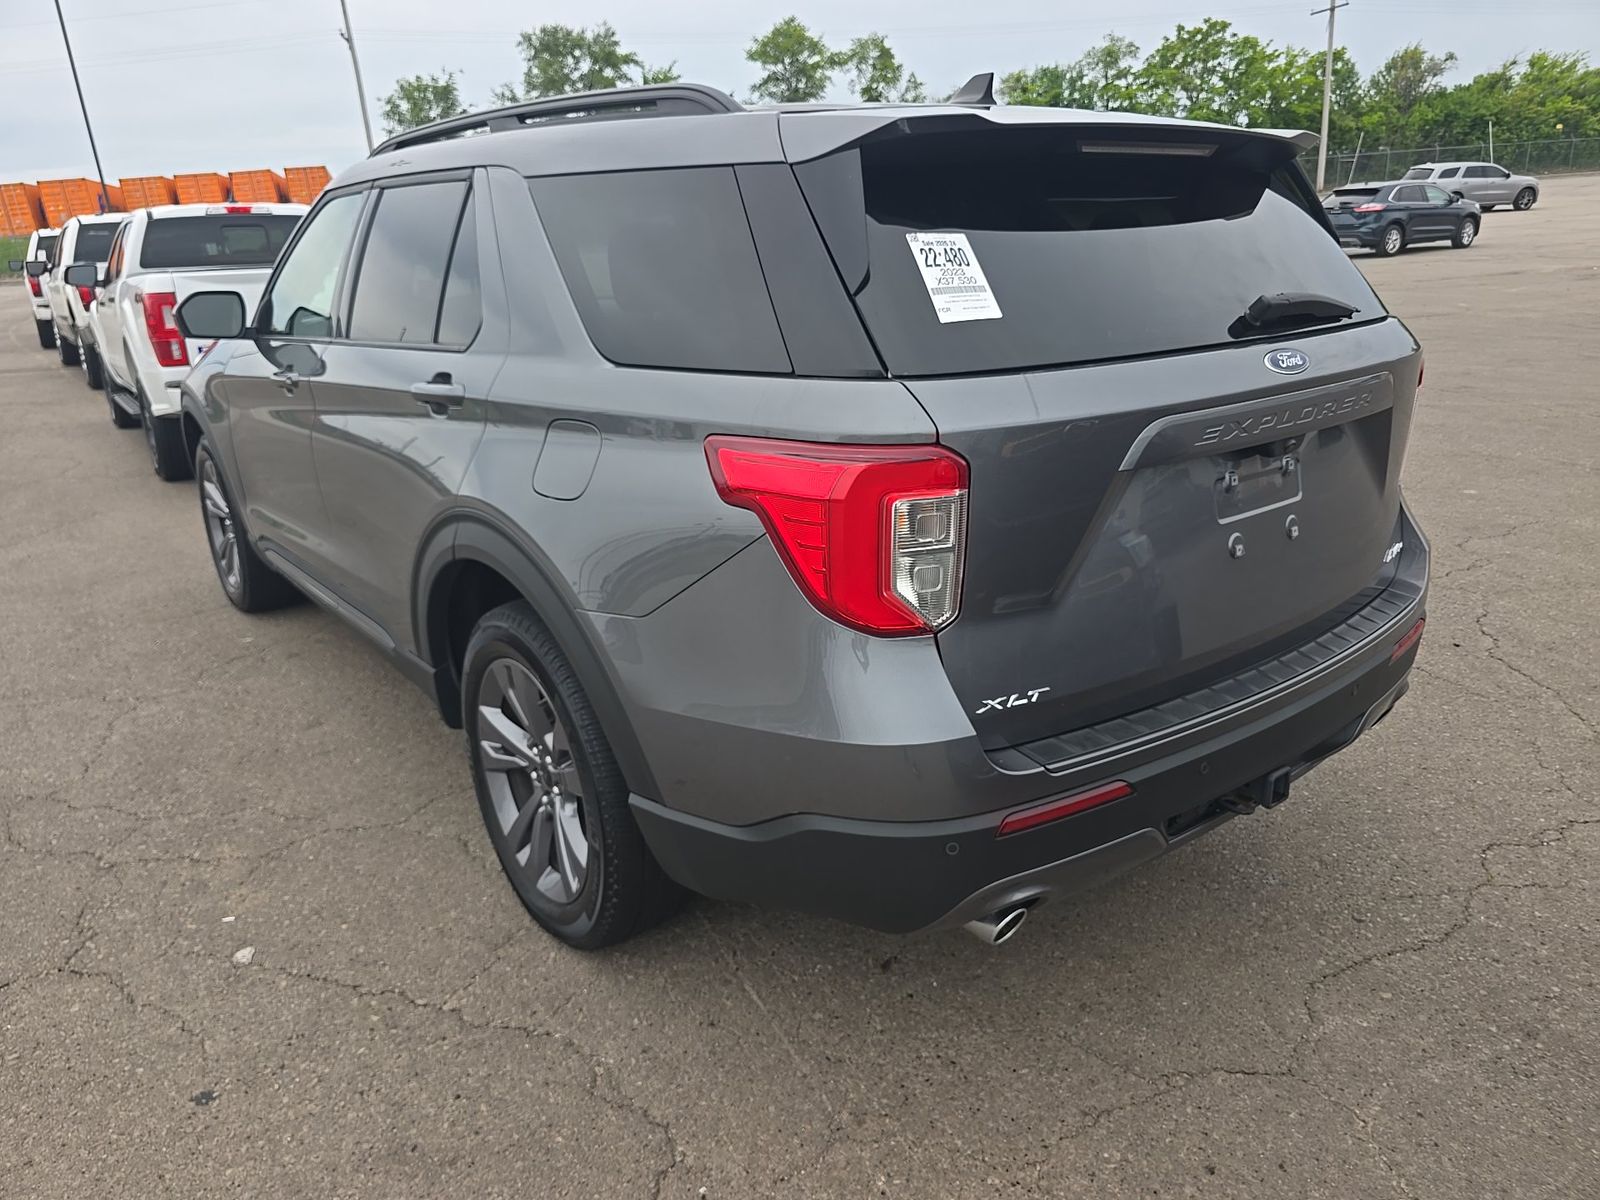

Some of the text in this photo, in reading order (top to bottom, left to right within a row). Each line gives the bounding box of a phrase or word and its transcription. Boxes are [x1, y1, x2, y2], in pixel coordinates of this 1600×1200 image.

[939, 268, 966, 277] 2023
[1276, 352, 1303, 368] Ford
[1194, 393, 1373, 446] EXPLORER
[975, 687, 1051, 714] XLT
